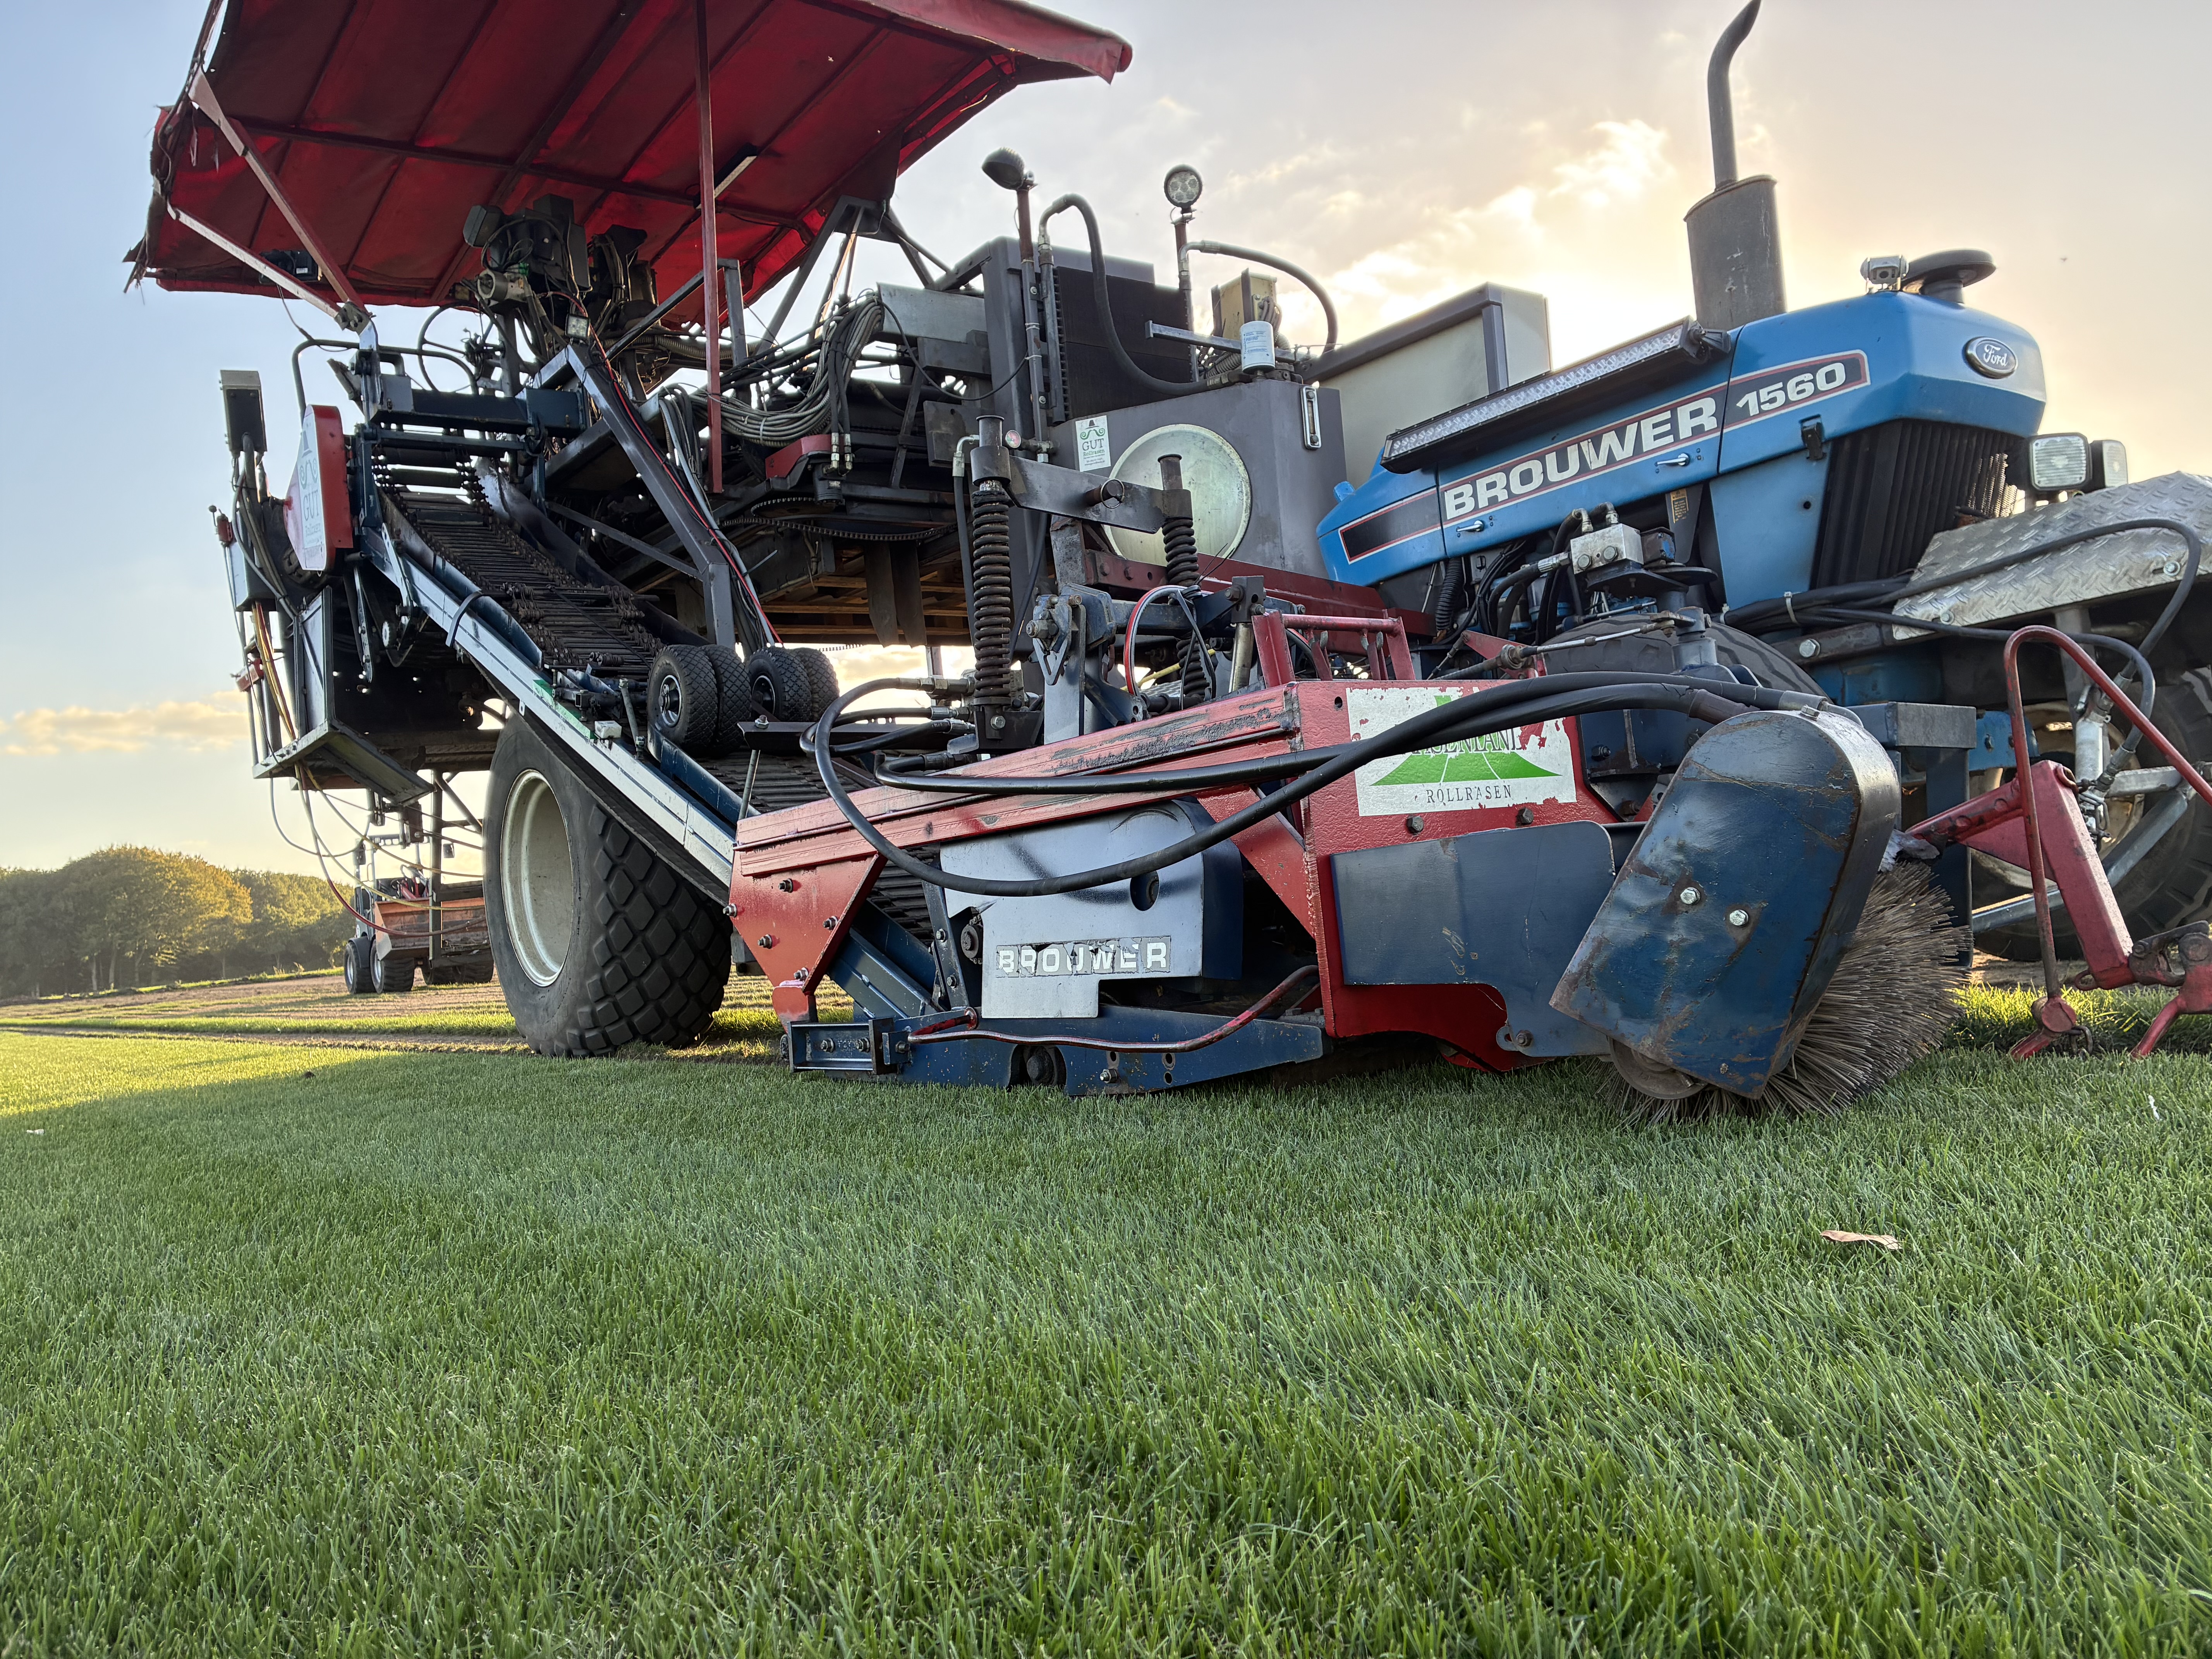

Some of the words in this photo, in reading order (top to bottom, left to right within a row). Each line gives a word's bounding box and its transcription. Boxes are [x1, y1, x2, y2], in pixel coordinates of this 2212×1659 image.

[1983, 344, 2008, 366] Ford
[1082, 438, 1104, 451] GUT
[1444, 397, 1717, 520] BROUWER
[1736, 362, 1846, 416] 1560
[303, 489, 319, 521] GUT
[1426, 785, 1511, 803] ROLLRASEN
[998, 942, 1166, 973] BROUWER
